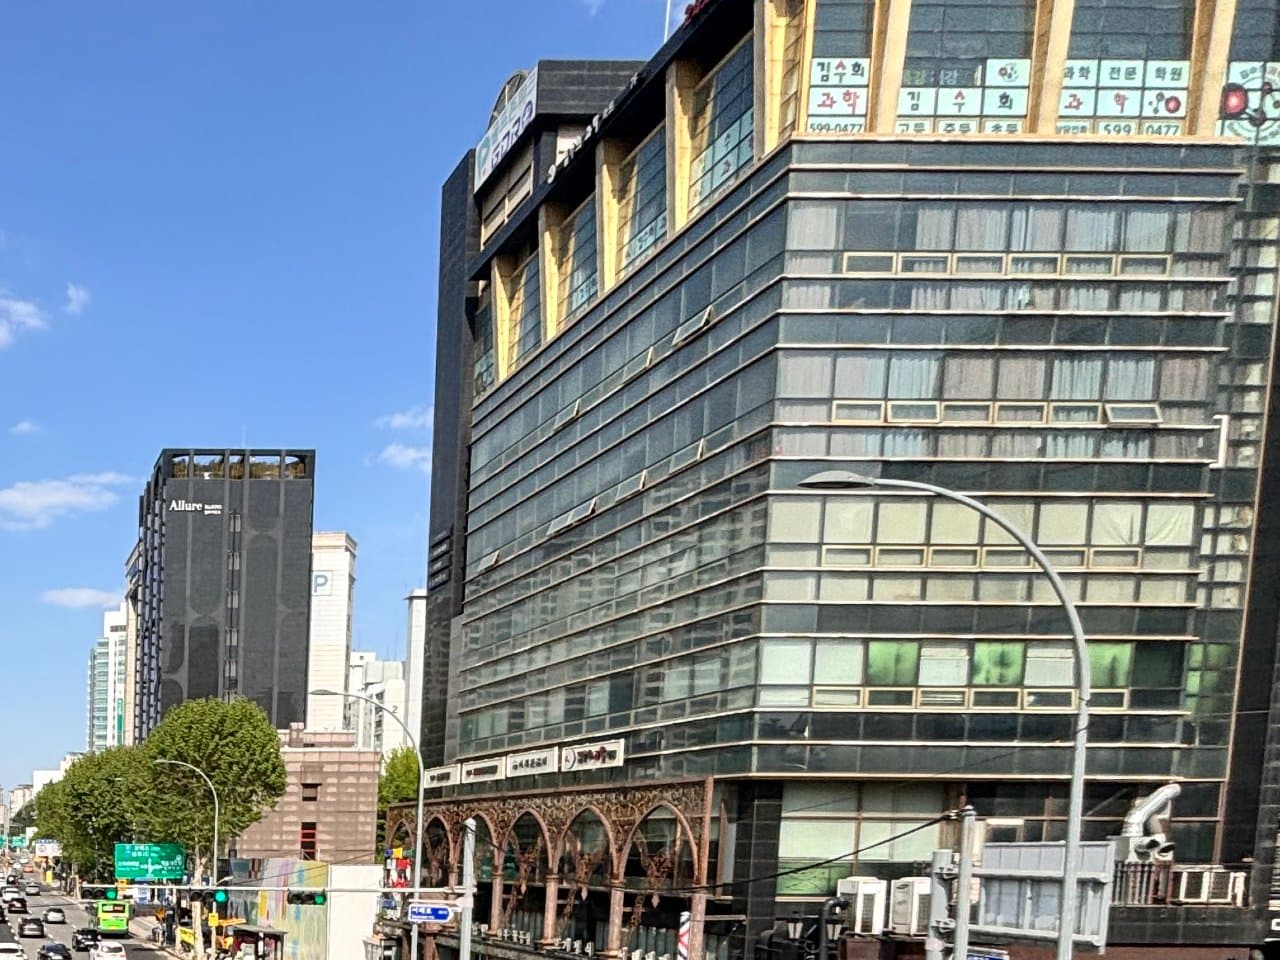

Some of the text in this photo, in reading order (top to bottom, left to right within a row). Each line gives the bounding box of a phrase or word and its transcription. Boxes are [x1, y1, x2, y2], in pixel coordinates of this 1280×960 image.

[816, 61, 865, 84] 김수희
[1108, 66, 1137, 81] 전문
[1154, 67, 1183, 82] 학원
[817, 89, 860, 116] 과학
[168, 499, 203, 511] Allure
[313, 574, 329, 593] P
